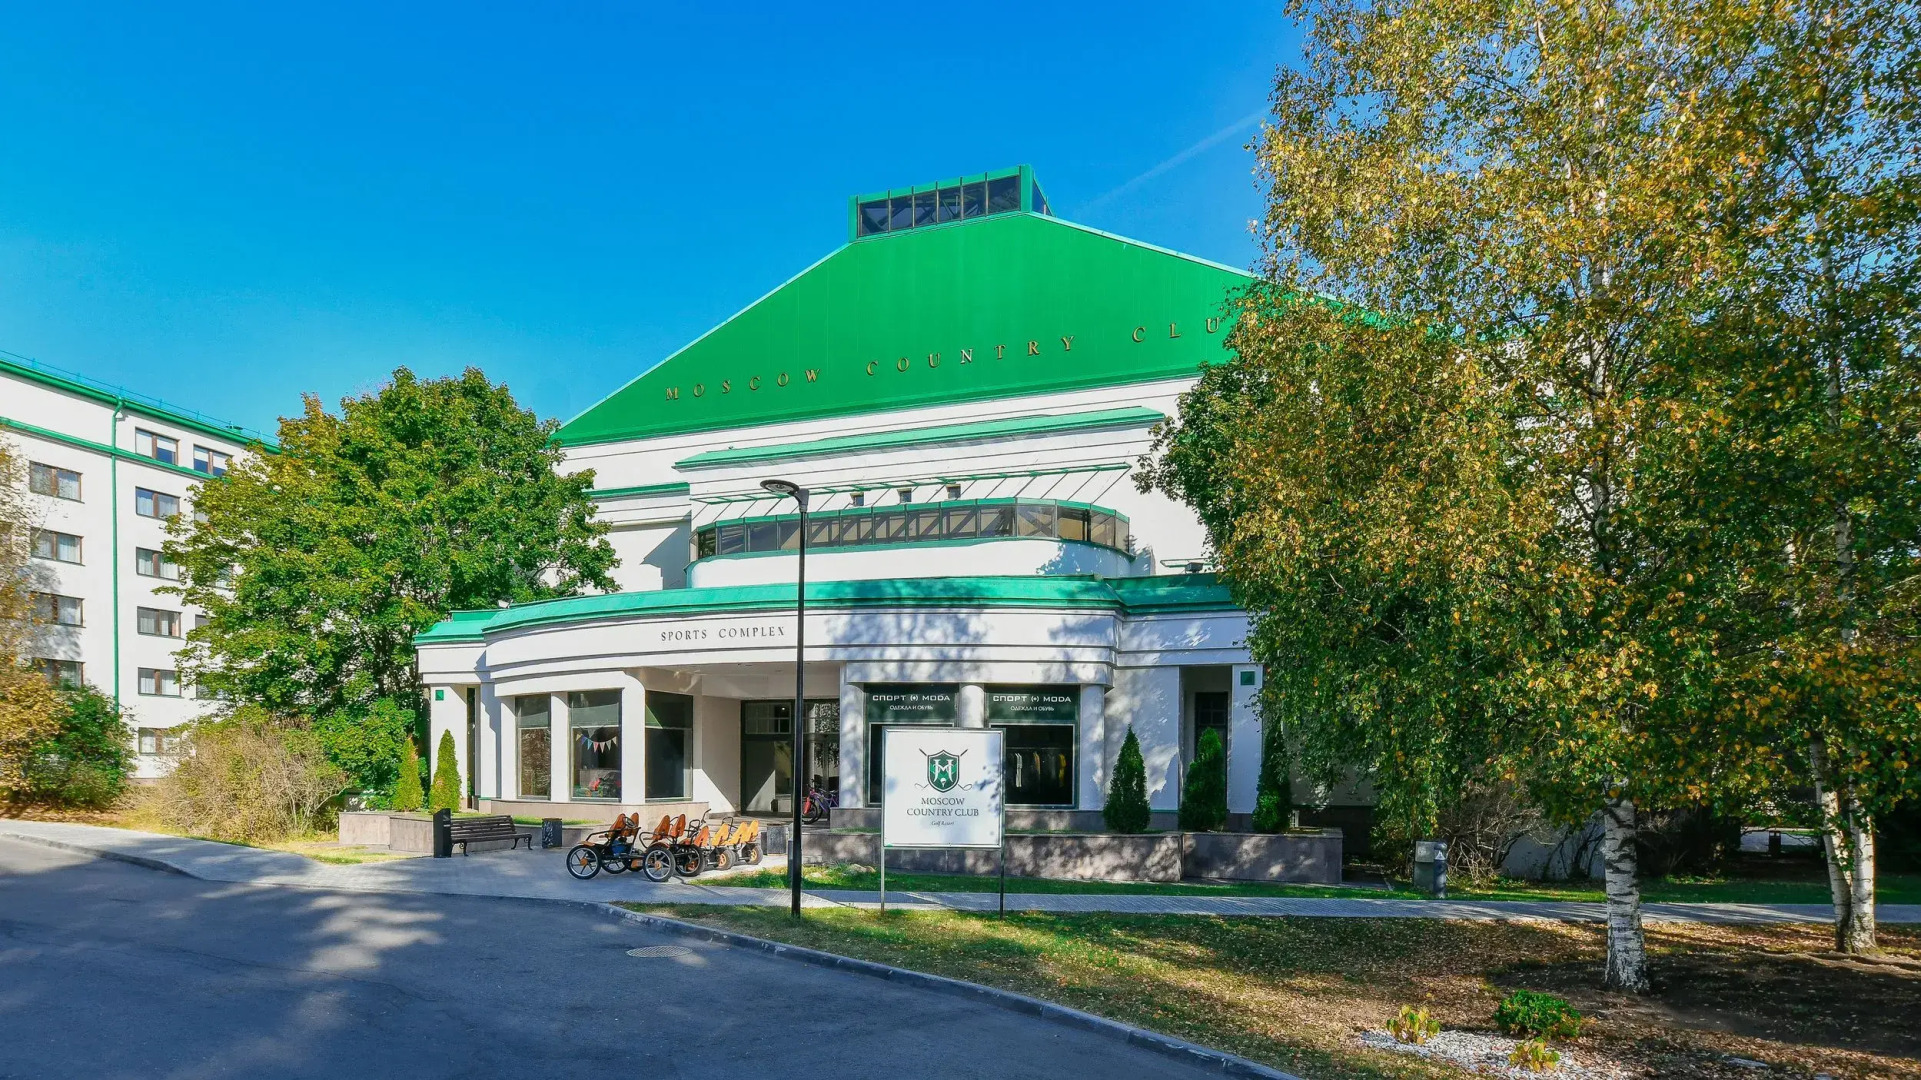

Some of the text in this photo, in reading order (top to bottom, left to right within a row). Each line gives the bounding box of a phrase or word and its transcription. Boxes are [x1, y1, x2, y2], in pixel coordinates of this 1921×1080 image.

[665, 317, 1220, 401] MOSCOW COUNTRY CLU
[660, 626, 785, 642] SPORTS COMPLEX
[921, 797, 965, 806] MOSCOW
[906, 808, 979, 817] COUNTRY CLUB
